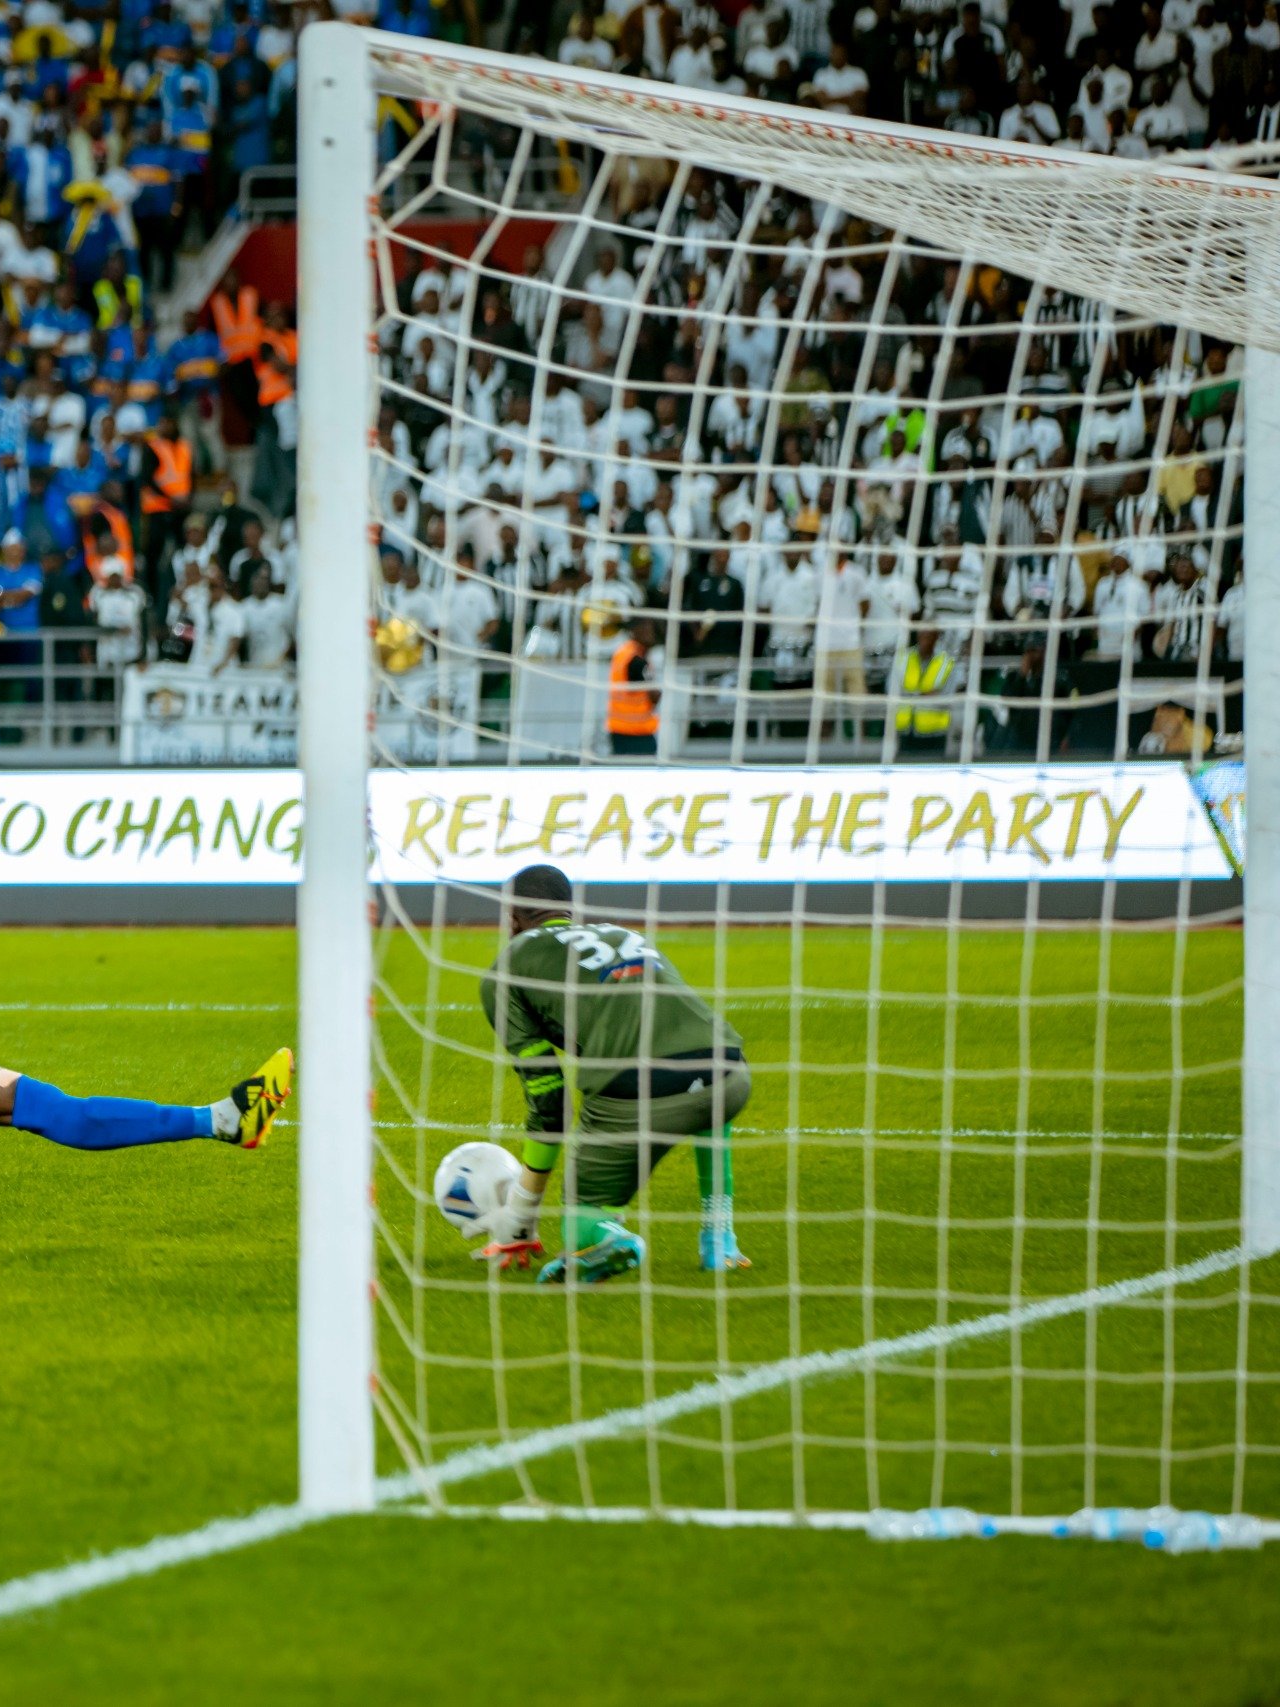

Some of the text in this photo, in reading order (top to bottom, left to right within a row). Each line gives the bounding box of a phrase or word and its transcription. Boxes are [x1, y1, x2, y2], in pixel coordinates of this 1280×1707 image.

[64, 796, 304, 866] CHANG
[401, 793, 731, 868] RELEASE
[749, 790, 890, 864] THE
[904, 785, 1147, 866] PARTY
